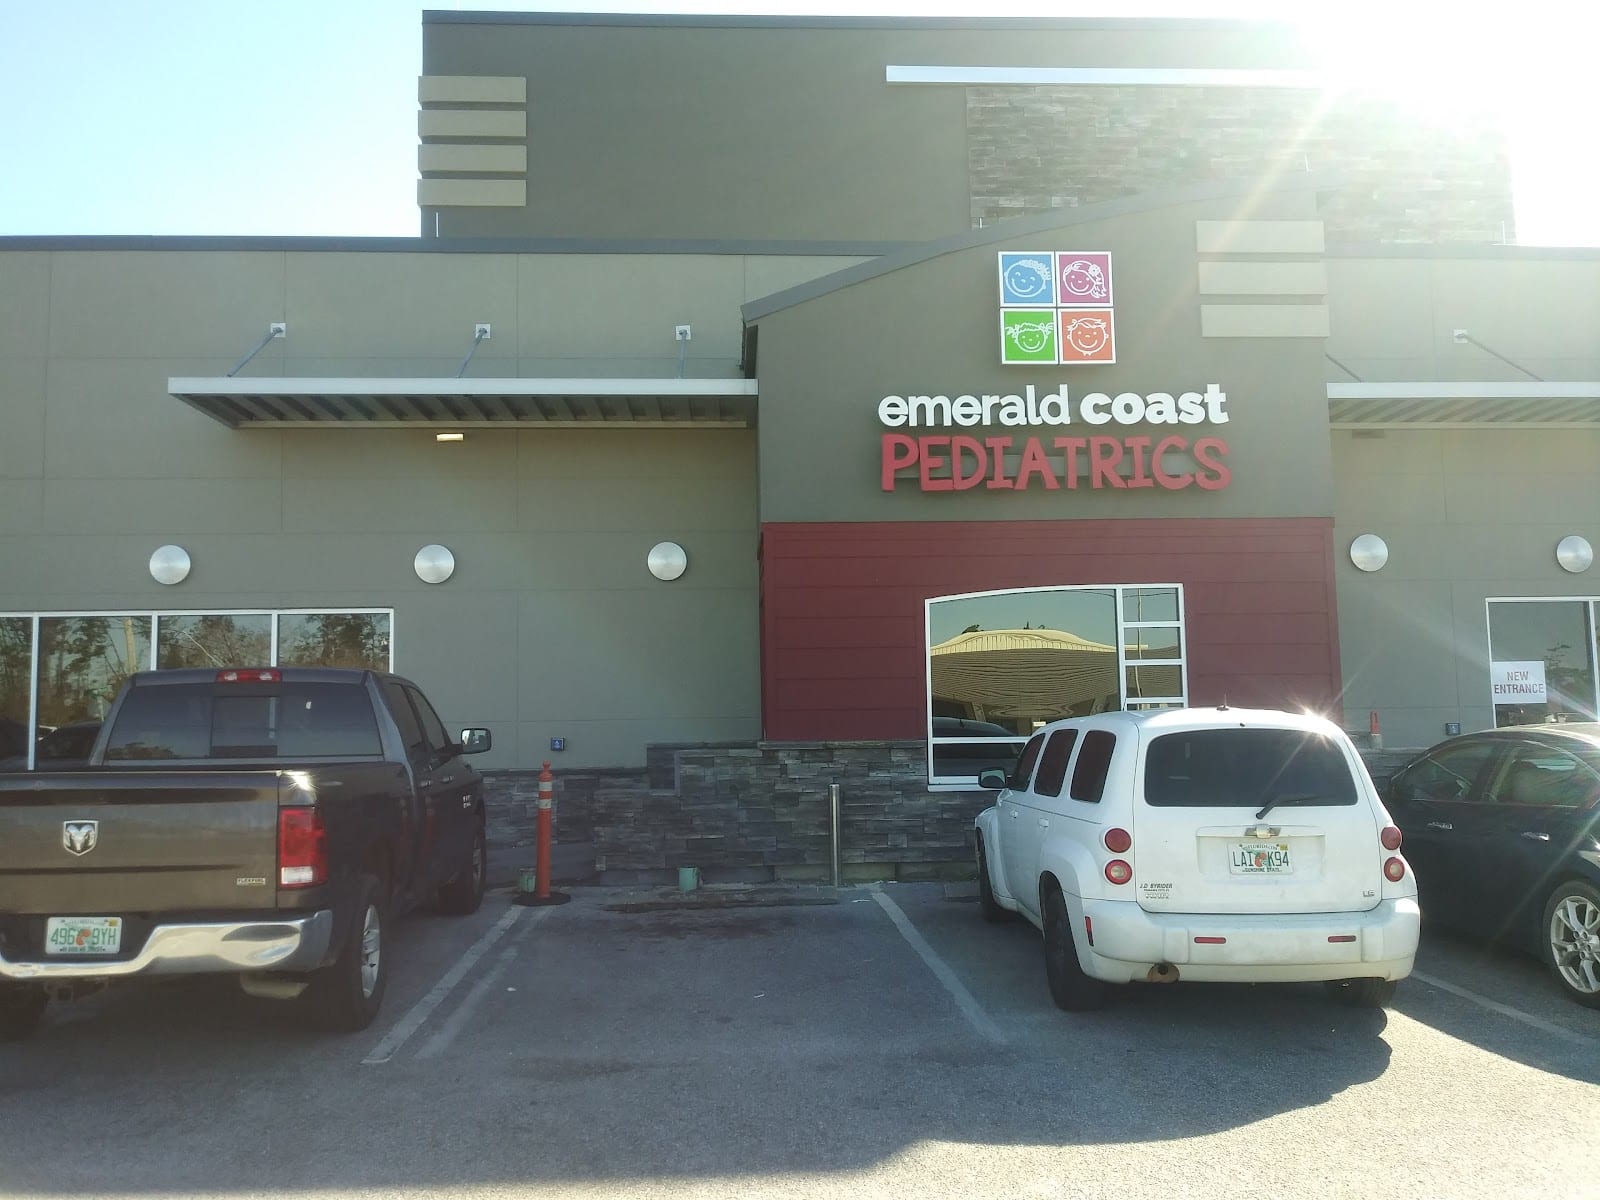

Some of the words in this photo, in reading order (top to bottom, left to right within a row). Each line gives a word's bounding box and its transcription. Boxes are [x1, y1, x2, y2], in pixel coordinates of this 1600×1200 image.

[878, 384, 1071, 427] emerald
[1080, 383, 1230, 425] coast
[881, 433, 1233, 492] PEDIATRICS
[1494, 683, 1545, 694] ENTRANCE
[1507, 671, 1529, 681] NEW
